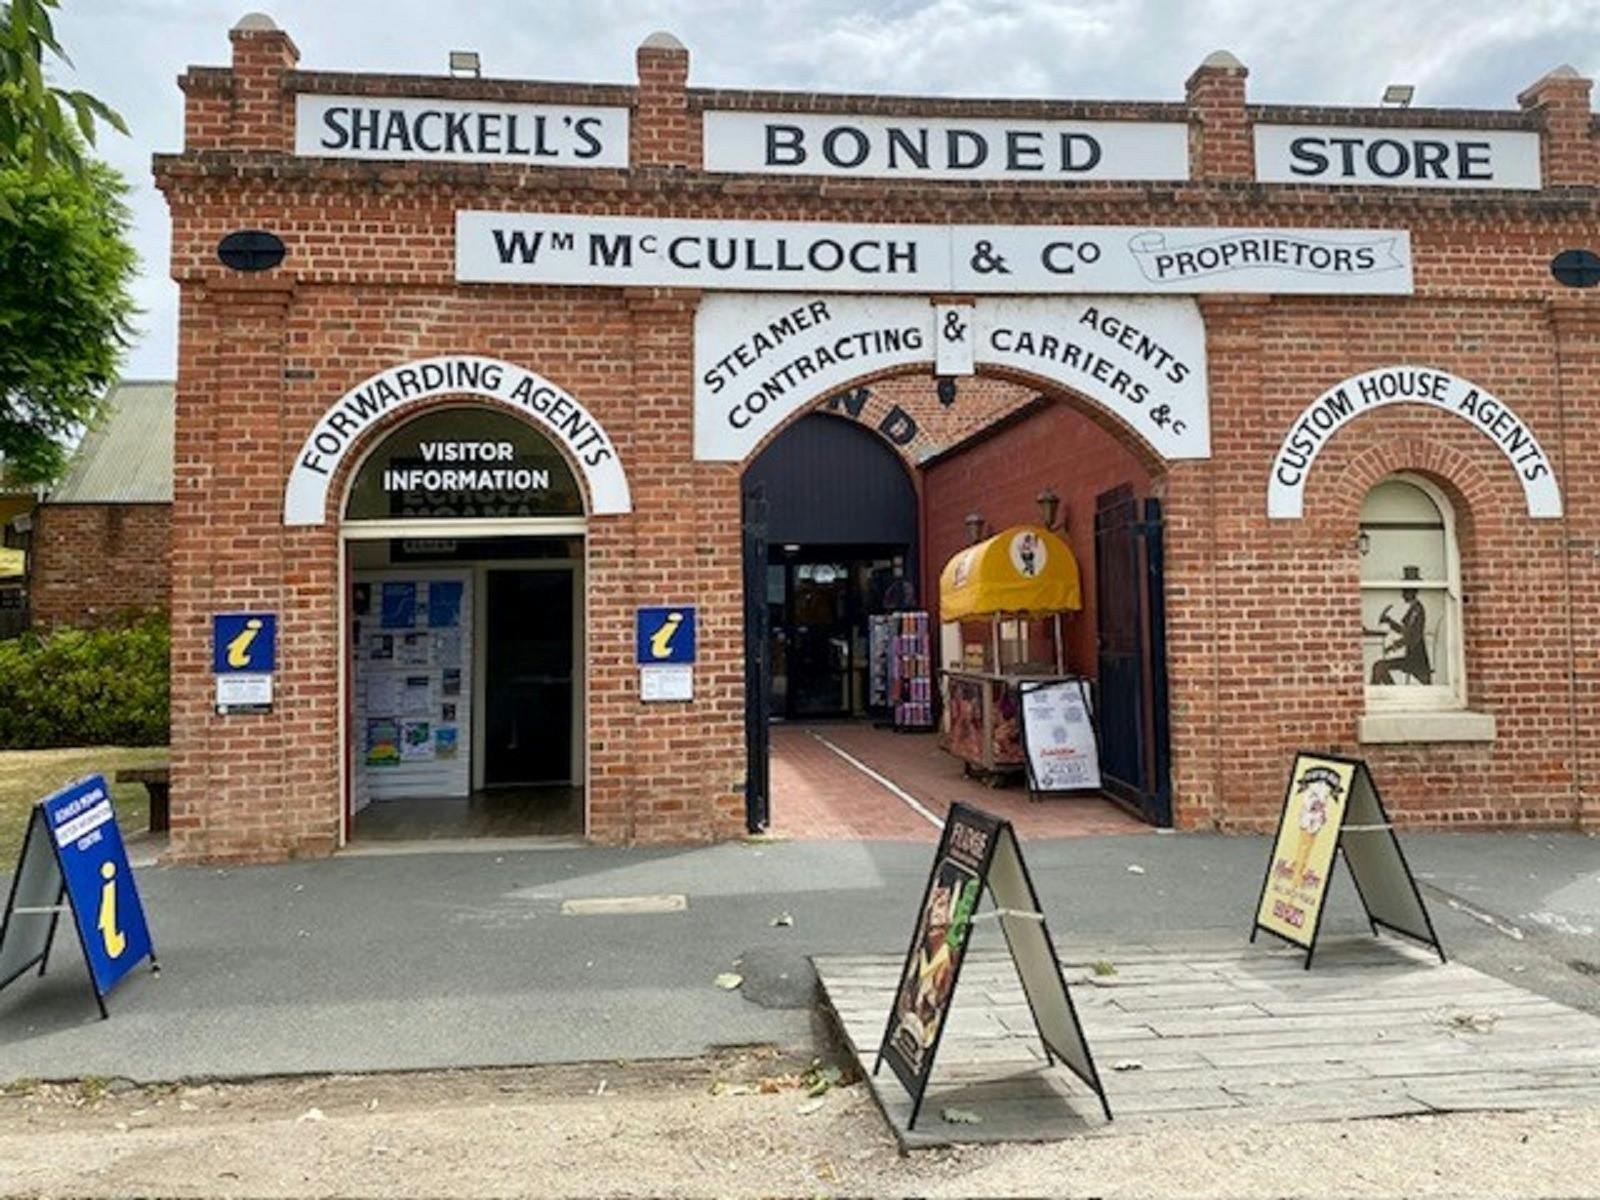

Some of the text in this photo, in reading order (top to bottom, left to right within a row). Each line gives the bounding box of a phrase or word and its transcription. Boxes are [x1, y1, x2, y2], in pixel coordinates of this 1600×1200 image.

[321, 106, 1494, 181] SHACKELL'S BONDED STORE
[970, 240, 1012, 275] &
[1156, 239, 1375, 277] PROPRIETORS
[703, 299, 1190, 394] STEAMER AGENTS
[728, 327, 923, 429] CONTRACTING
[943, 310, 967, 343] &
[991, 328, 1150, 405] CARRIERS
[301, 361, 612, 479] FORWARDING AGENTS
[420, 442, 515, 462] VISITOR
[1277, 372, 1548, 487] CUSTOM HOUSE AGENTS
[384, 469, 549, 491] INFORMATION
